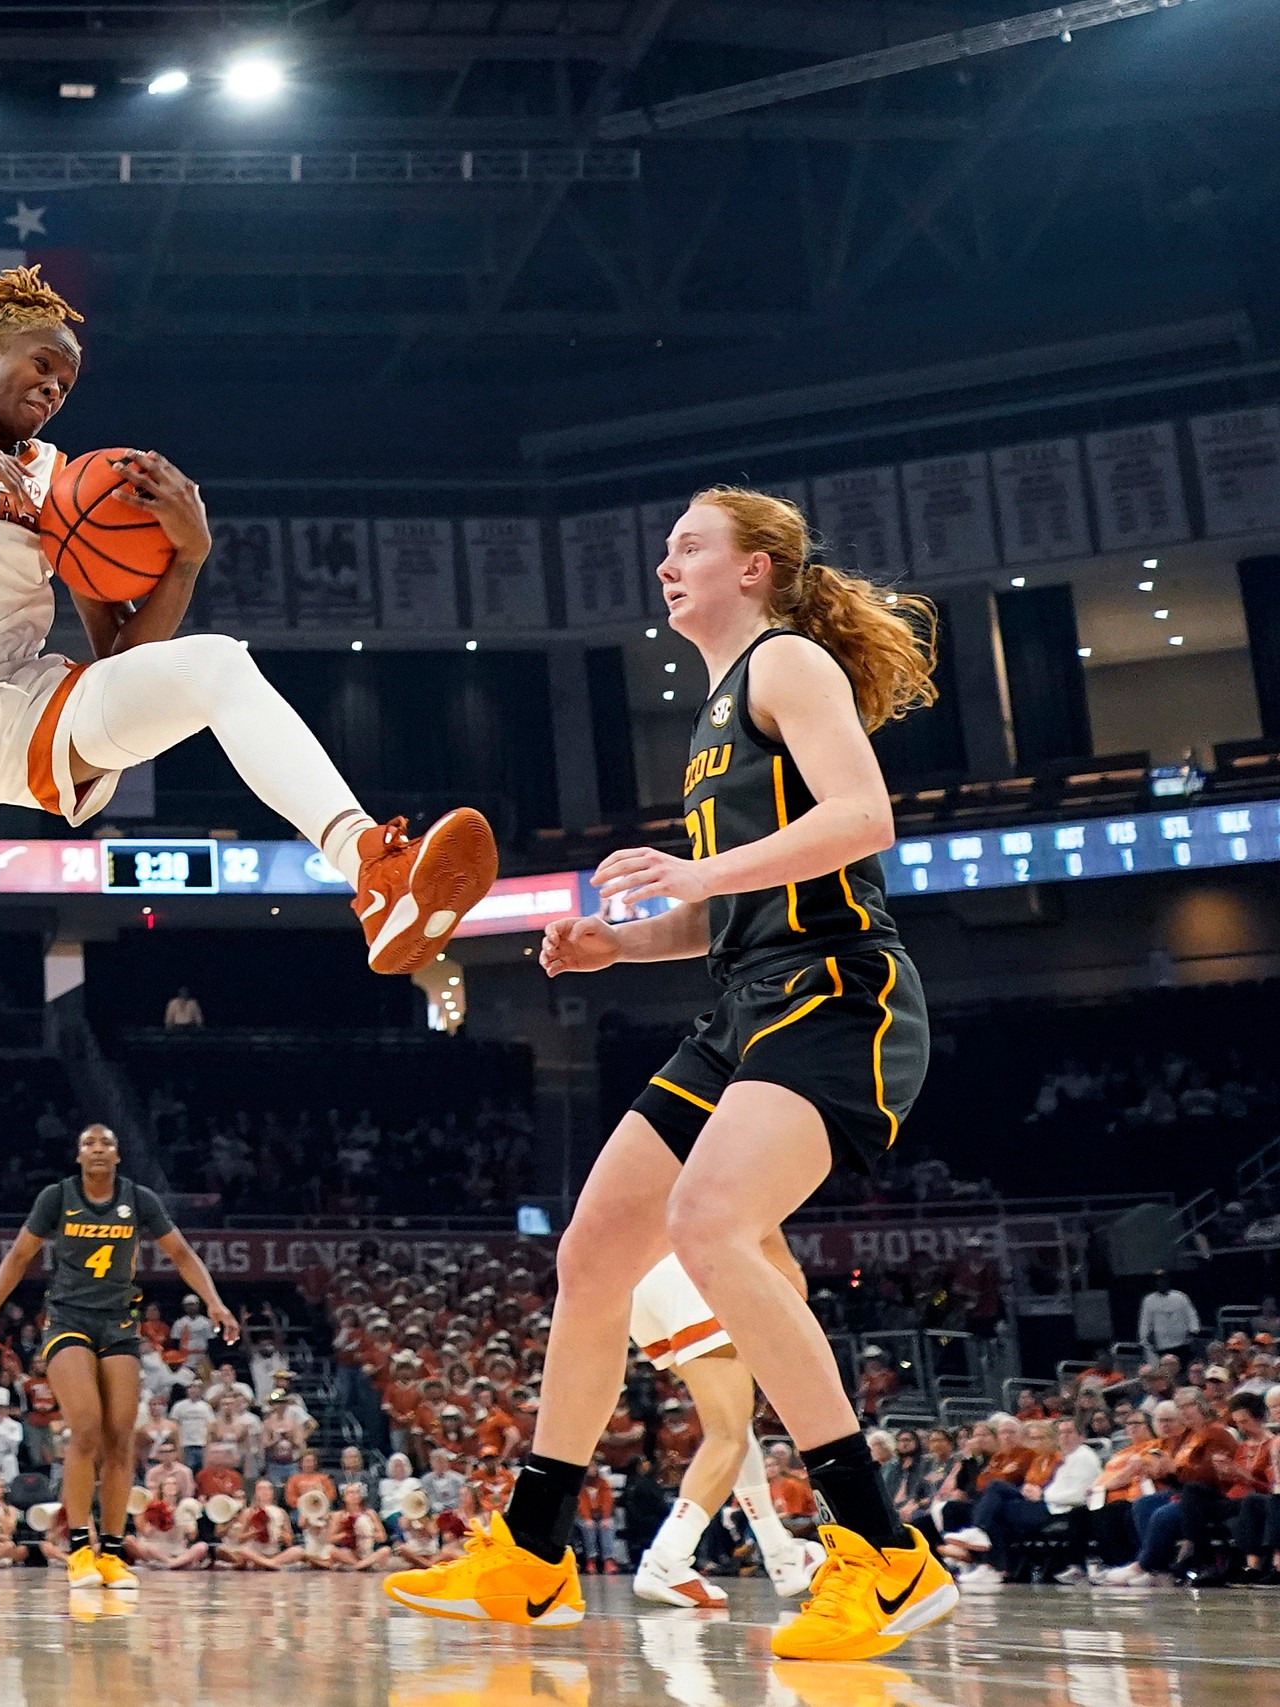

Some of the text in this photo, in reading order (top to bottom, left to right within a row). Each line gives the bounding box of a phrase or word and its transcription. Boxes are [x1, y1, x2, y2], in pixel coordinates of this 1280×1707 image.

[963, 863, 980, 886] 2
[1013, 858, 1030, 881] 2
[1122, 848, 1134, 871] 1
[63, 1223, 134, 1239] MIZZOU
[84, 1244, 116, 1278] 4
